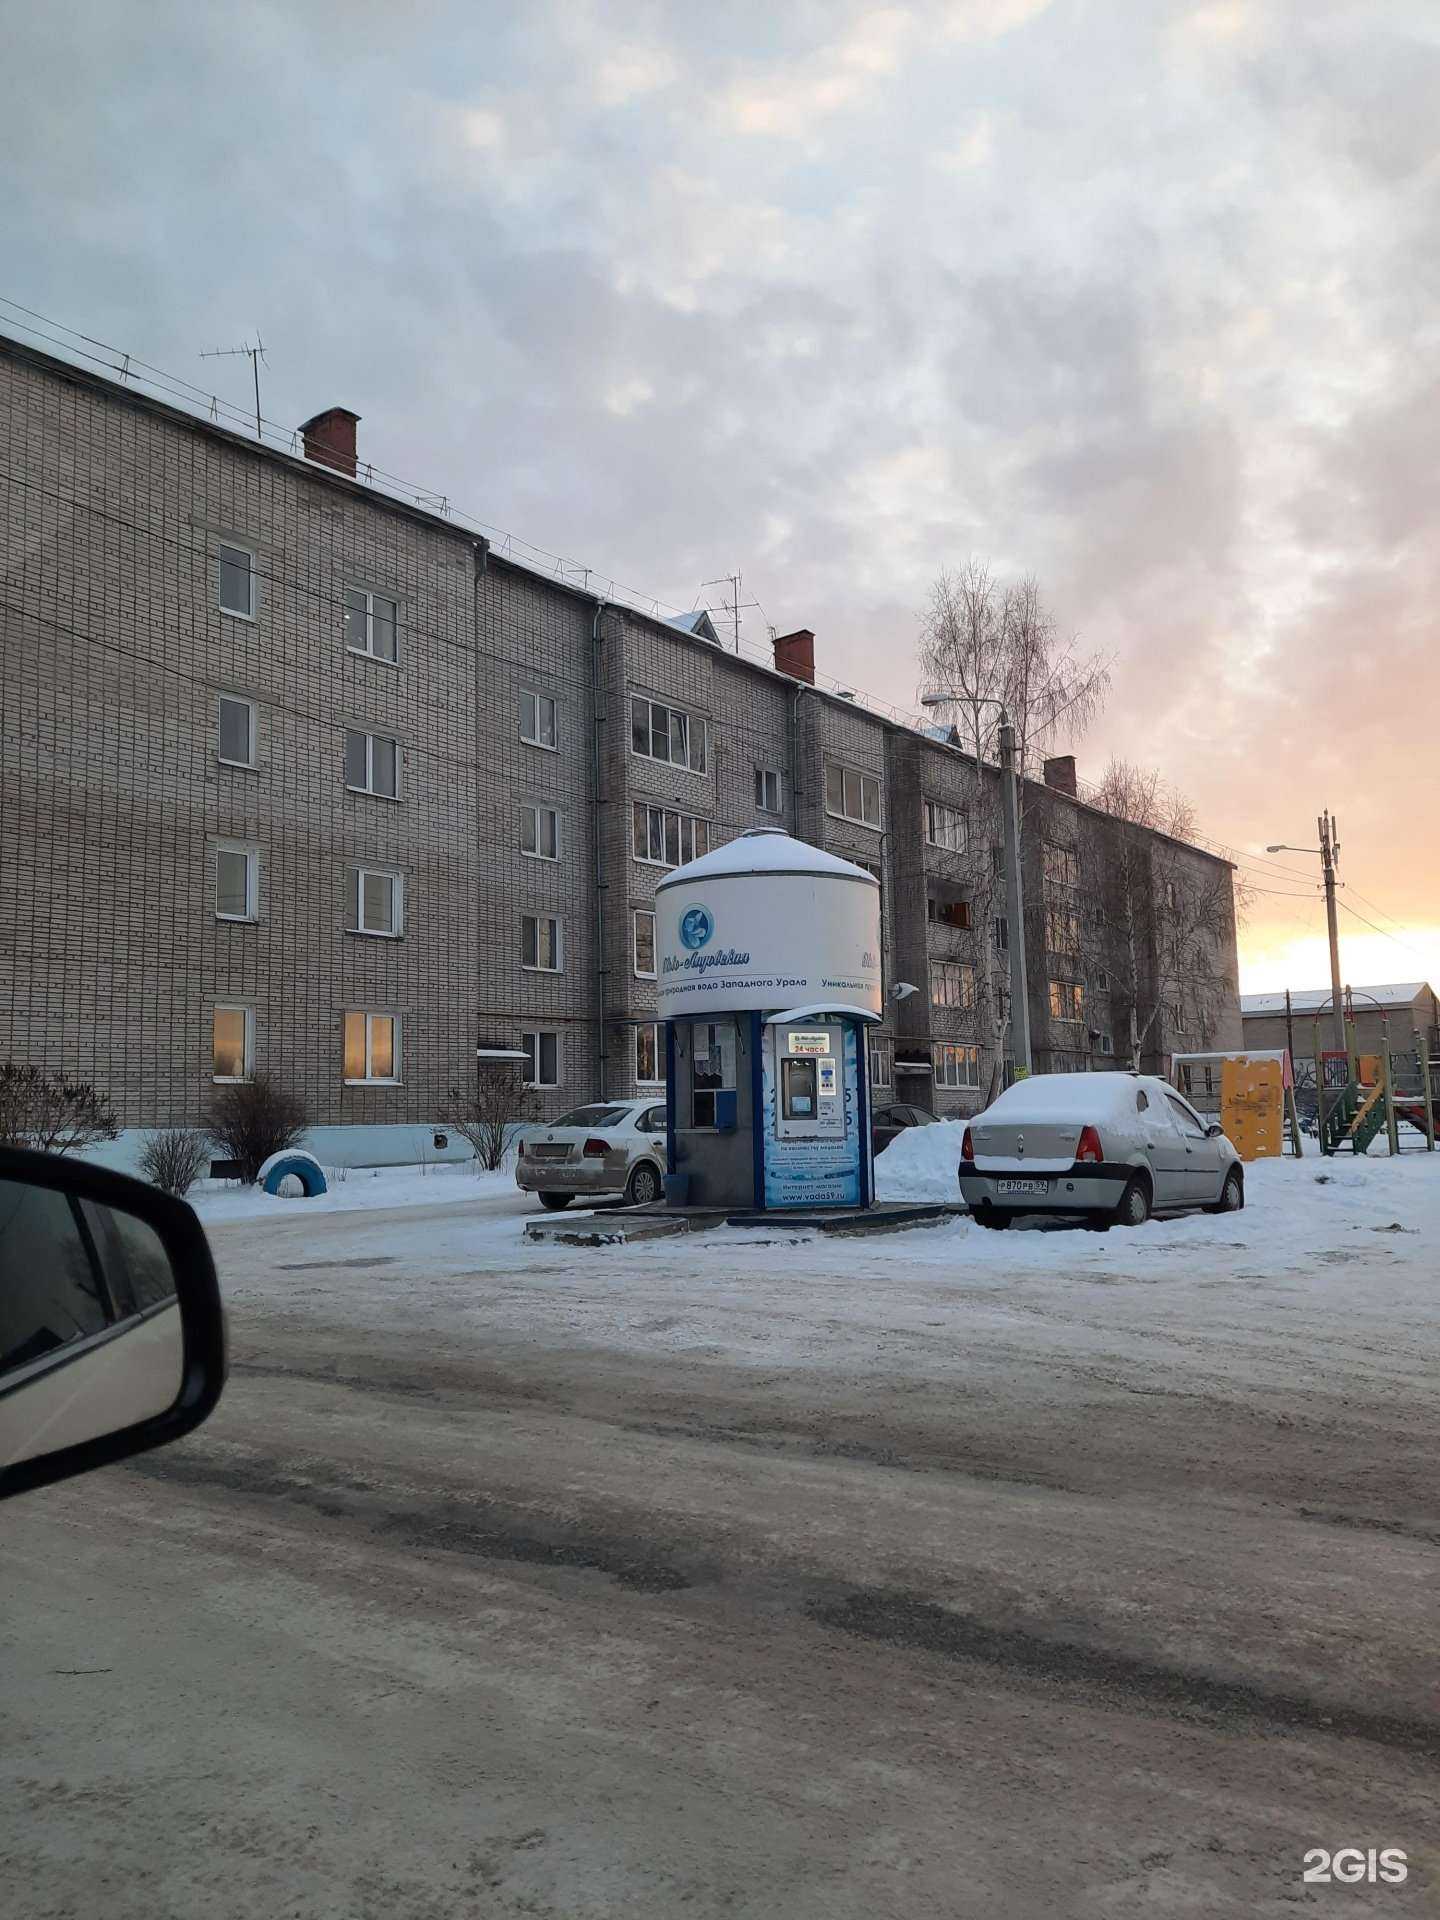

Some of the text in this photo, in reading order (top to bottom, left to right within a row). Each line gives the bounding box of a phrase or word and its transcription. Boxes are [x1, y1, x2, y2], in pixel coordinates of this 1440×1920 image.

[697, 983, 719, 991] вода
[720, 979, 773, 989] Западного
[775, 978, 807, 988] Урала
